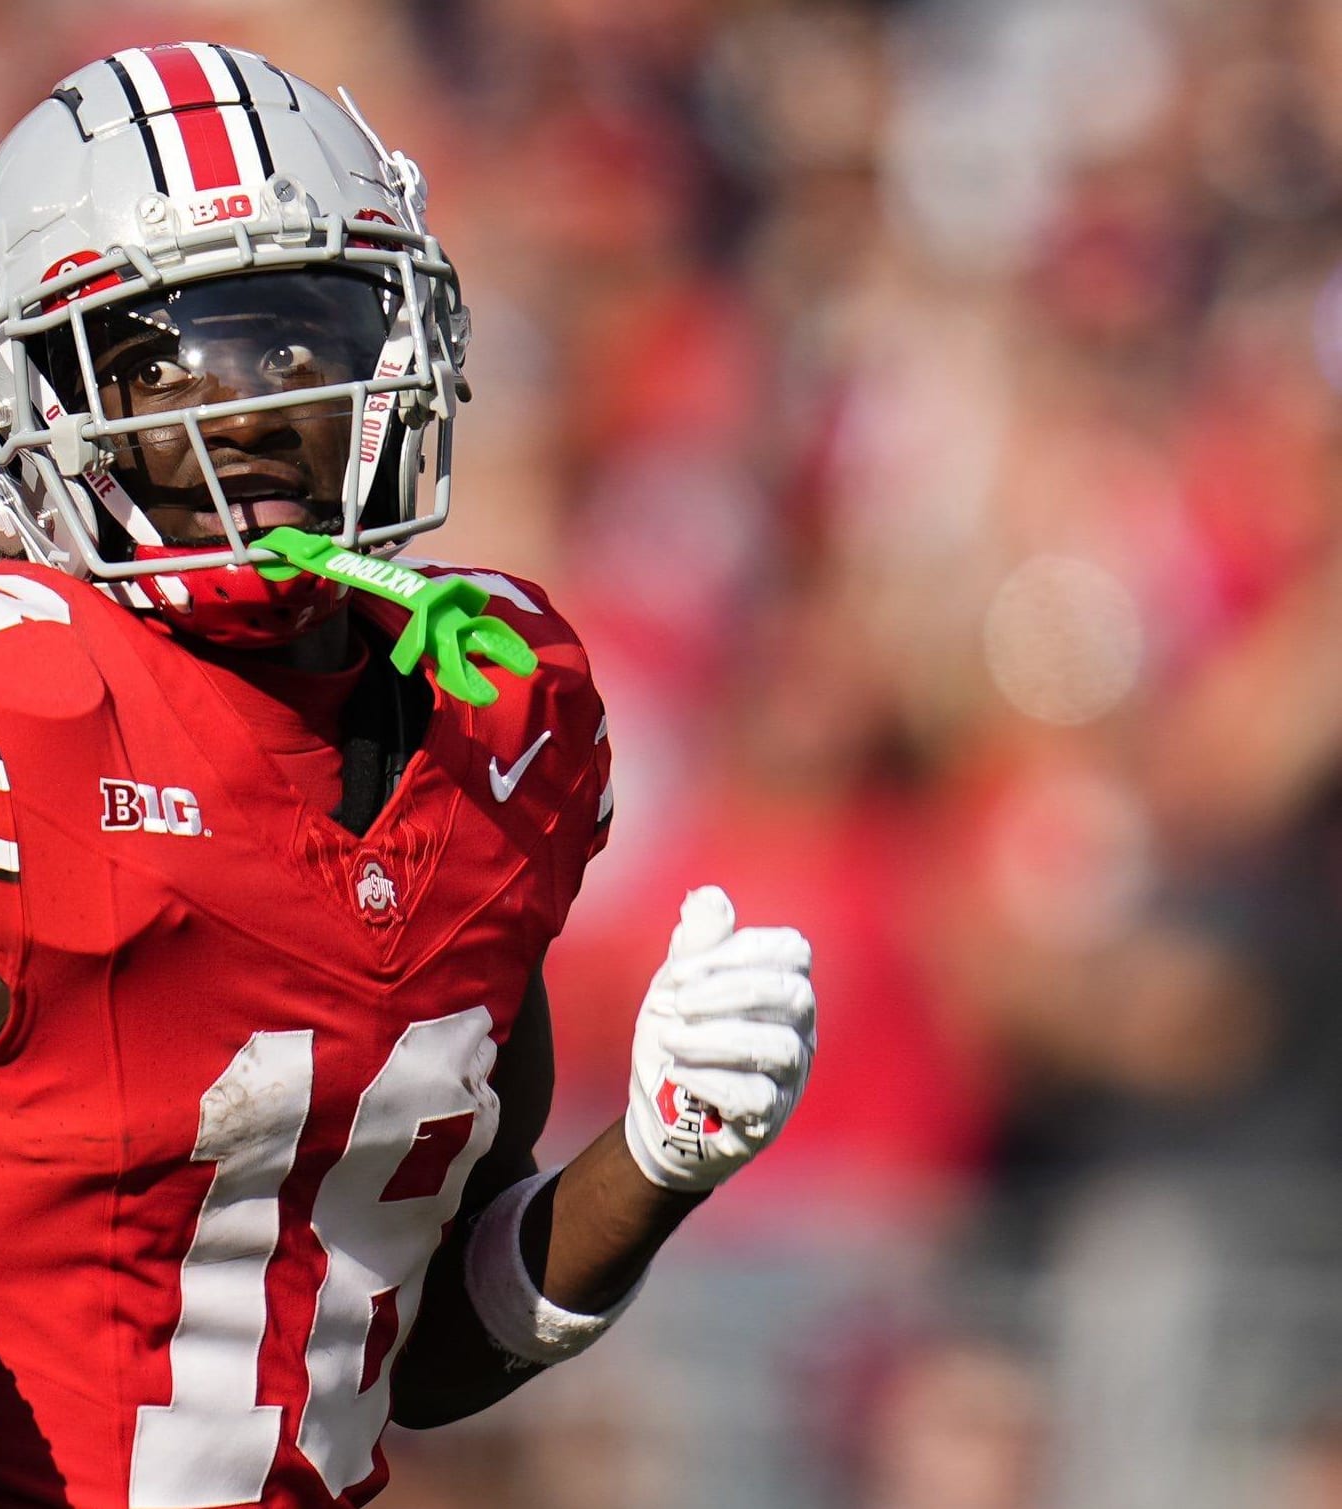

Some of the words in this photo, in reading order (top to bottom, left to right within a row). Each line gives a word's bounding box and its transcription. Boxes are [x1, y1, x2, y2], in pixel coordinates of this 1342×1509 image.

[369, 361, 402, 412] STTE
[359, 418, 382, 463] OHIO
[325, 552, 427, 599] NXTRND
[129, 1005, 500, 1509] 18
